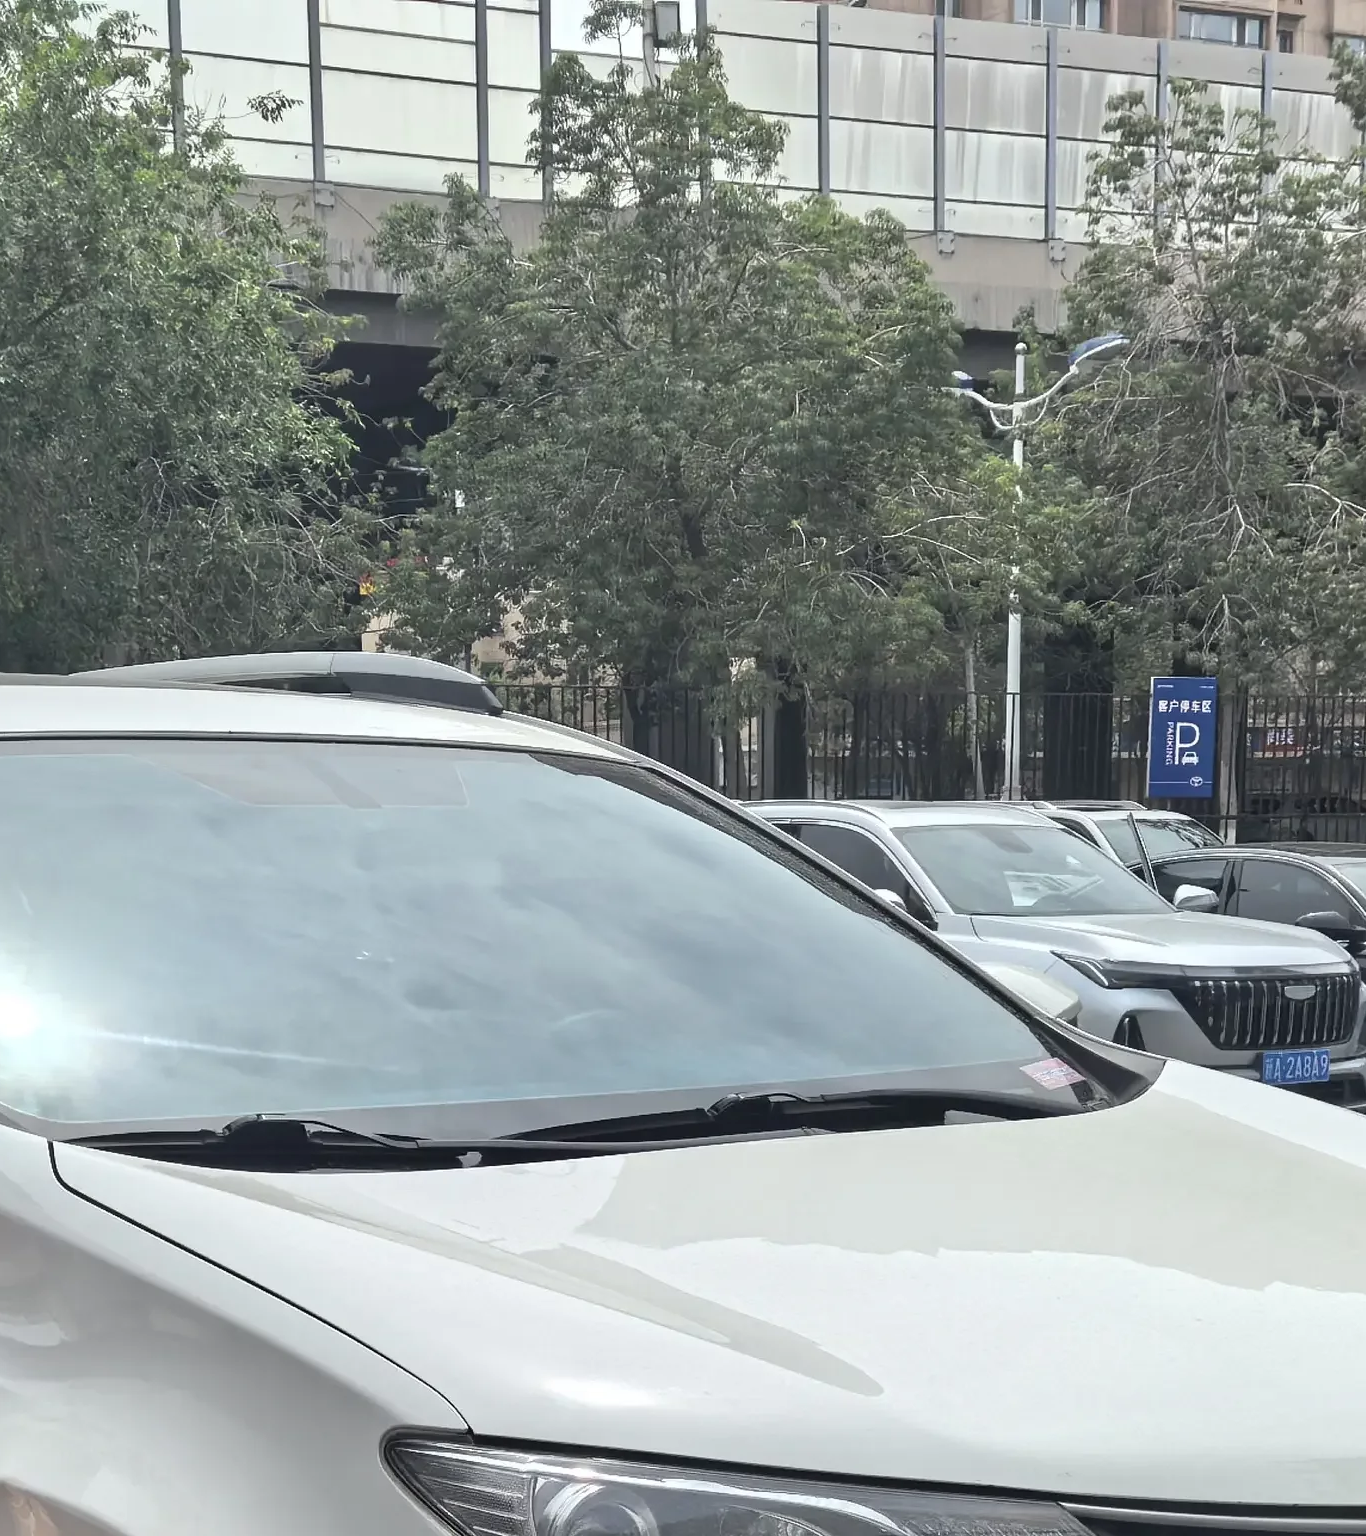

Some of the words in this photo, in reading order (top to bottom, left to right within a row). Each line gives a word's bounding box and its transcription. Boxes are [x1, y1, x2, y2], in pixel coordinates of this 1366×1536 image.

[1158, 699, 1213, 714] 客户停车区
[1165, 721, 1175, 766] PARKING
